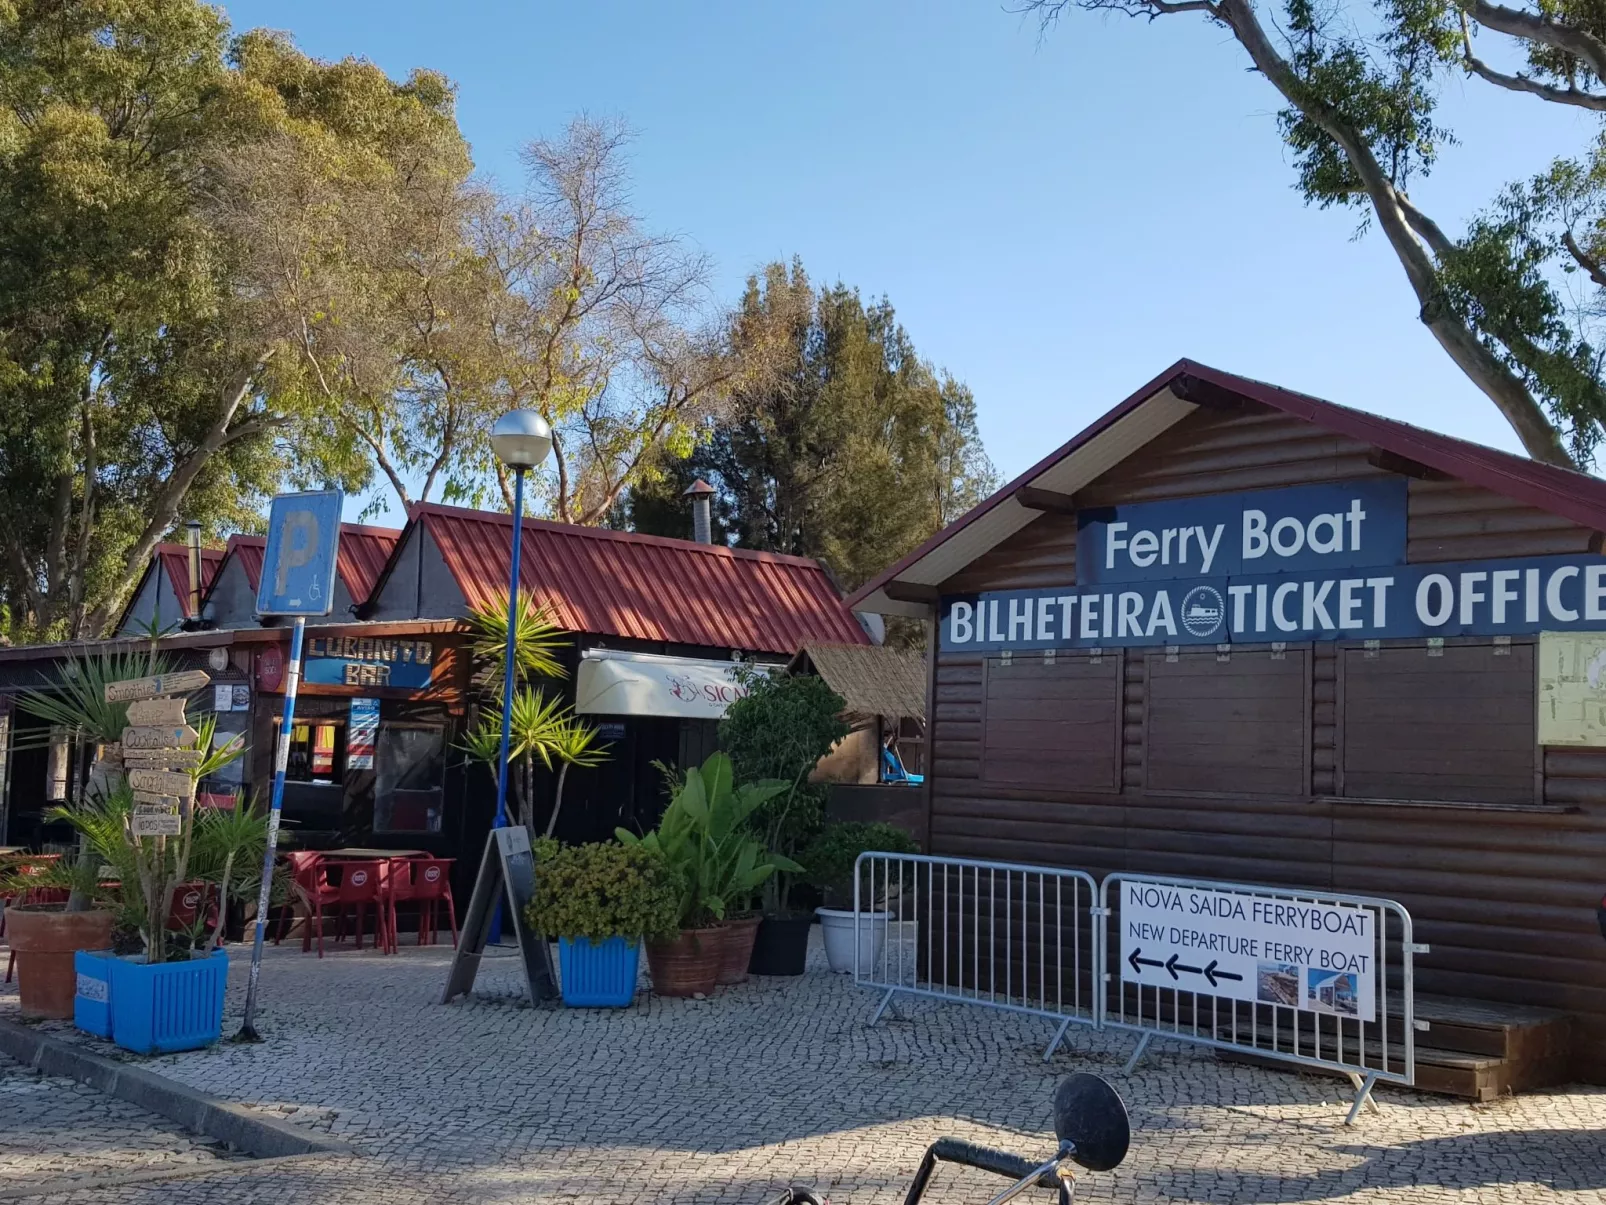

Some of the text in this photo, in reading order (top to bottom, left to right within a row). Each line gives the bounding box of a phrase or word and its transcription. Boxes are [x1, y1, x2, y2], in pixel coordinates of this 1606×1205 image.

[274, 511, 319, 596] P
[1105, 499, 1367, 574] Ferry Boat
[950, 565, 1606, 644] BILHETEIRA TICKET OFFICE
[108, 682, 157, 701] Smoothies
[345, 663, 391, 686] BAR
[126, 729, 169, 748] Cocktails
[1130, 886, 1368, 937] NOVA SAIDA FERRYBOAT
[1129, 922, 1369, 974] NEW DEPARTURE FERRY BOAT
